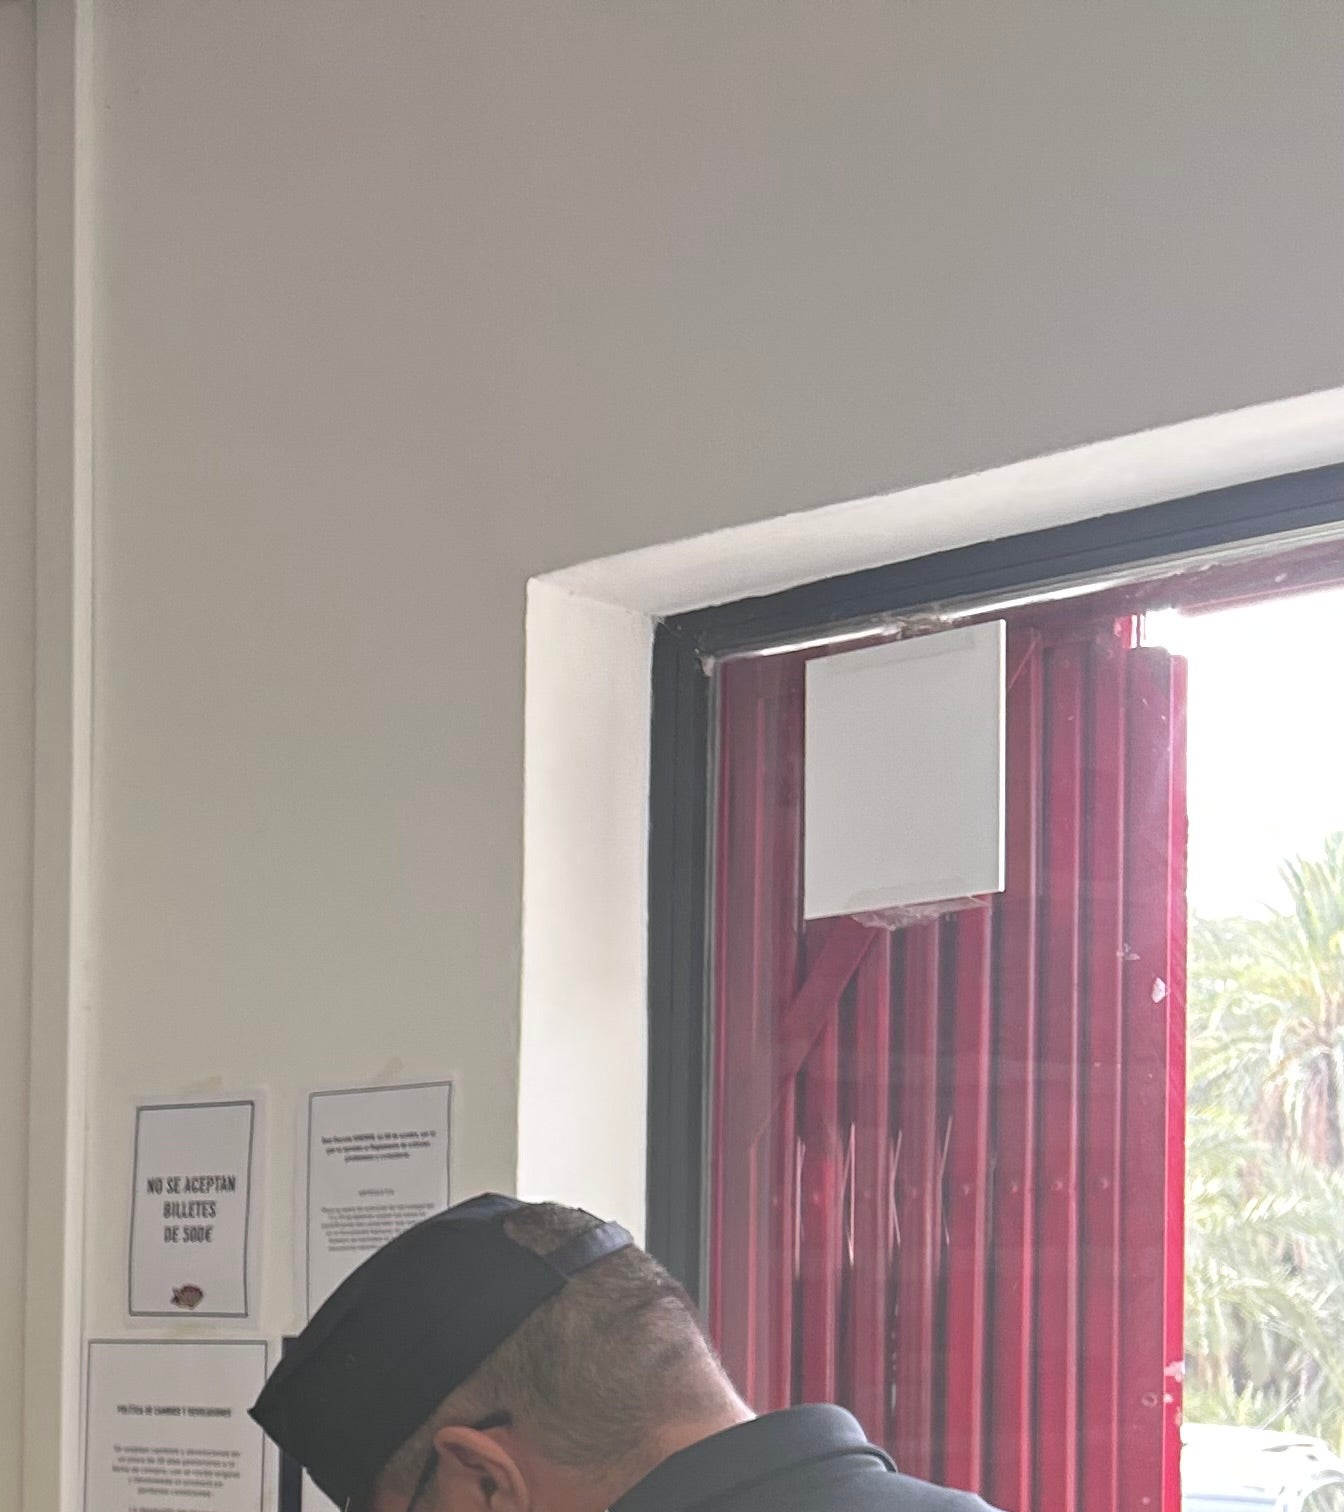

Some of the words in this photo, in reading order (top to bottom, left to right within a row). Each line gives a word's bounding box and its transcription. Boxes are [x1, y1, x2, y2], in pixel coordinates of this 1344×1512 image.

[146, 1177, 164, 1194] NO
[167, 1176, 181, 1193] SE
[184, 1174, 237, 1194] ACEPTAN
[163, 1201, 217, 1219] BILLETES
[164, 1226, 179, 1244] DE
